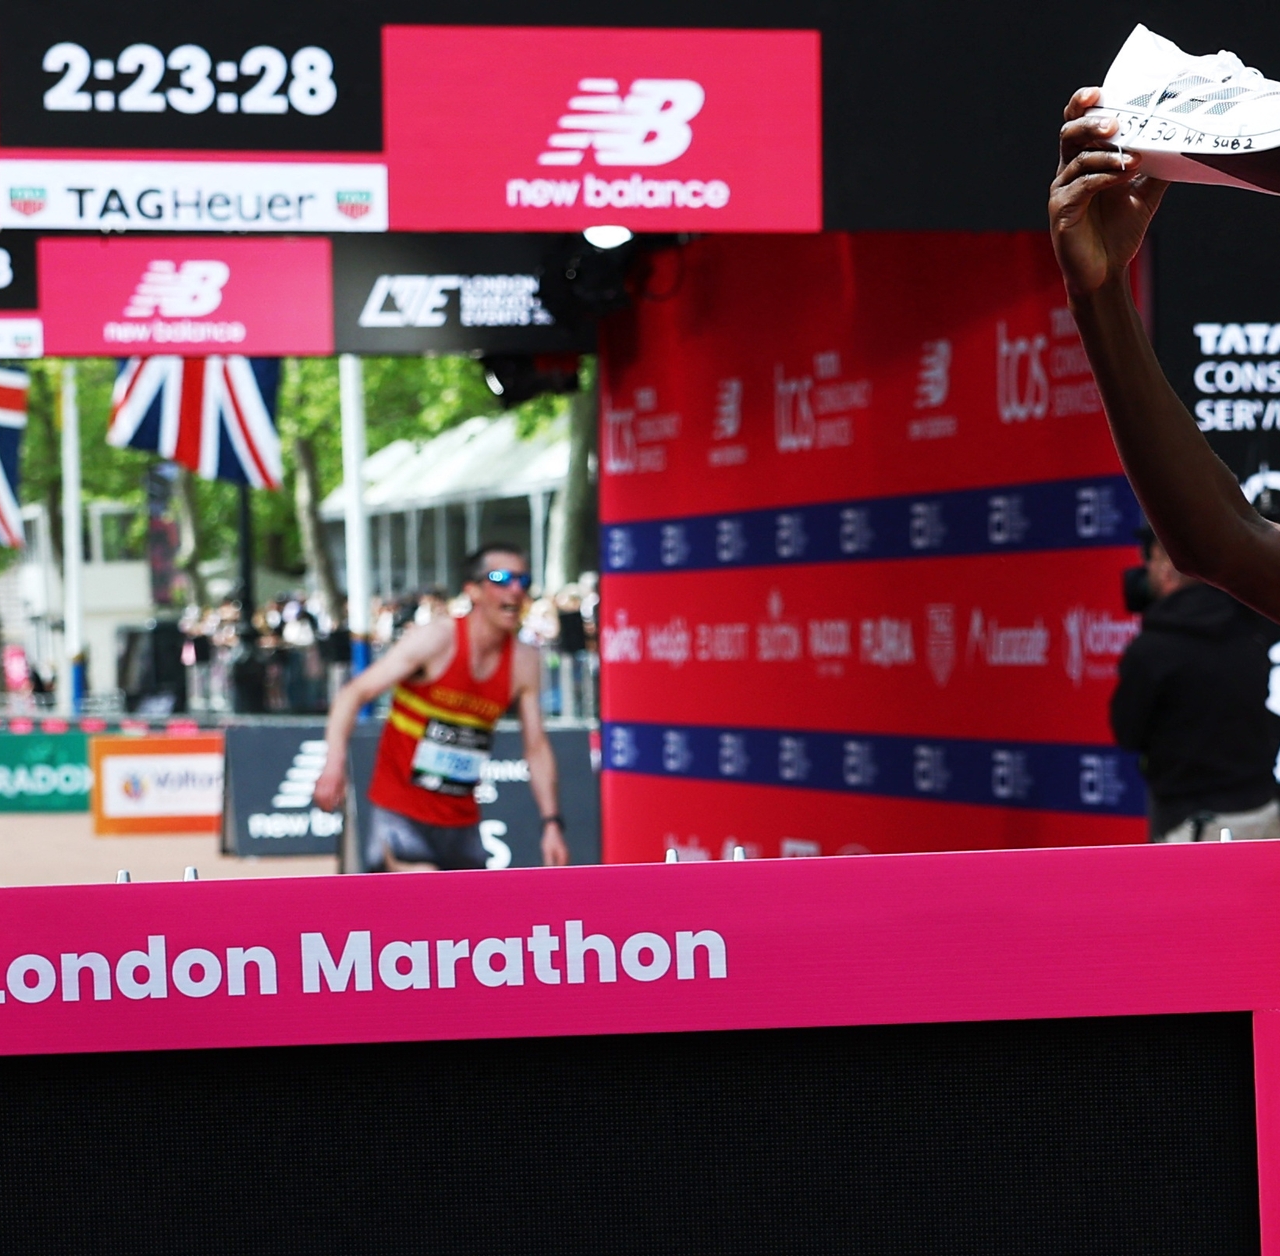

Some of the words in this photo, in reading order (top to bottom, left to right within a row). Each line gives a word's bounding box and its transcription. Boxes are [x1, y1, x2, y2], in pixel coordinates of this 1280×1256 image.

[42, 42, 337, 115] 2:23:28
[507, 178, 580, 206] new
[584, 173, 730, 208] balance
[300, 919, 728, 994] Marathon
